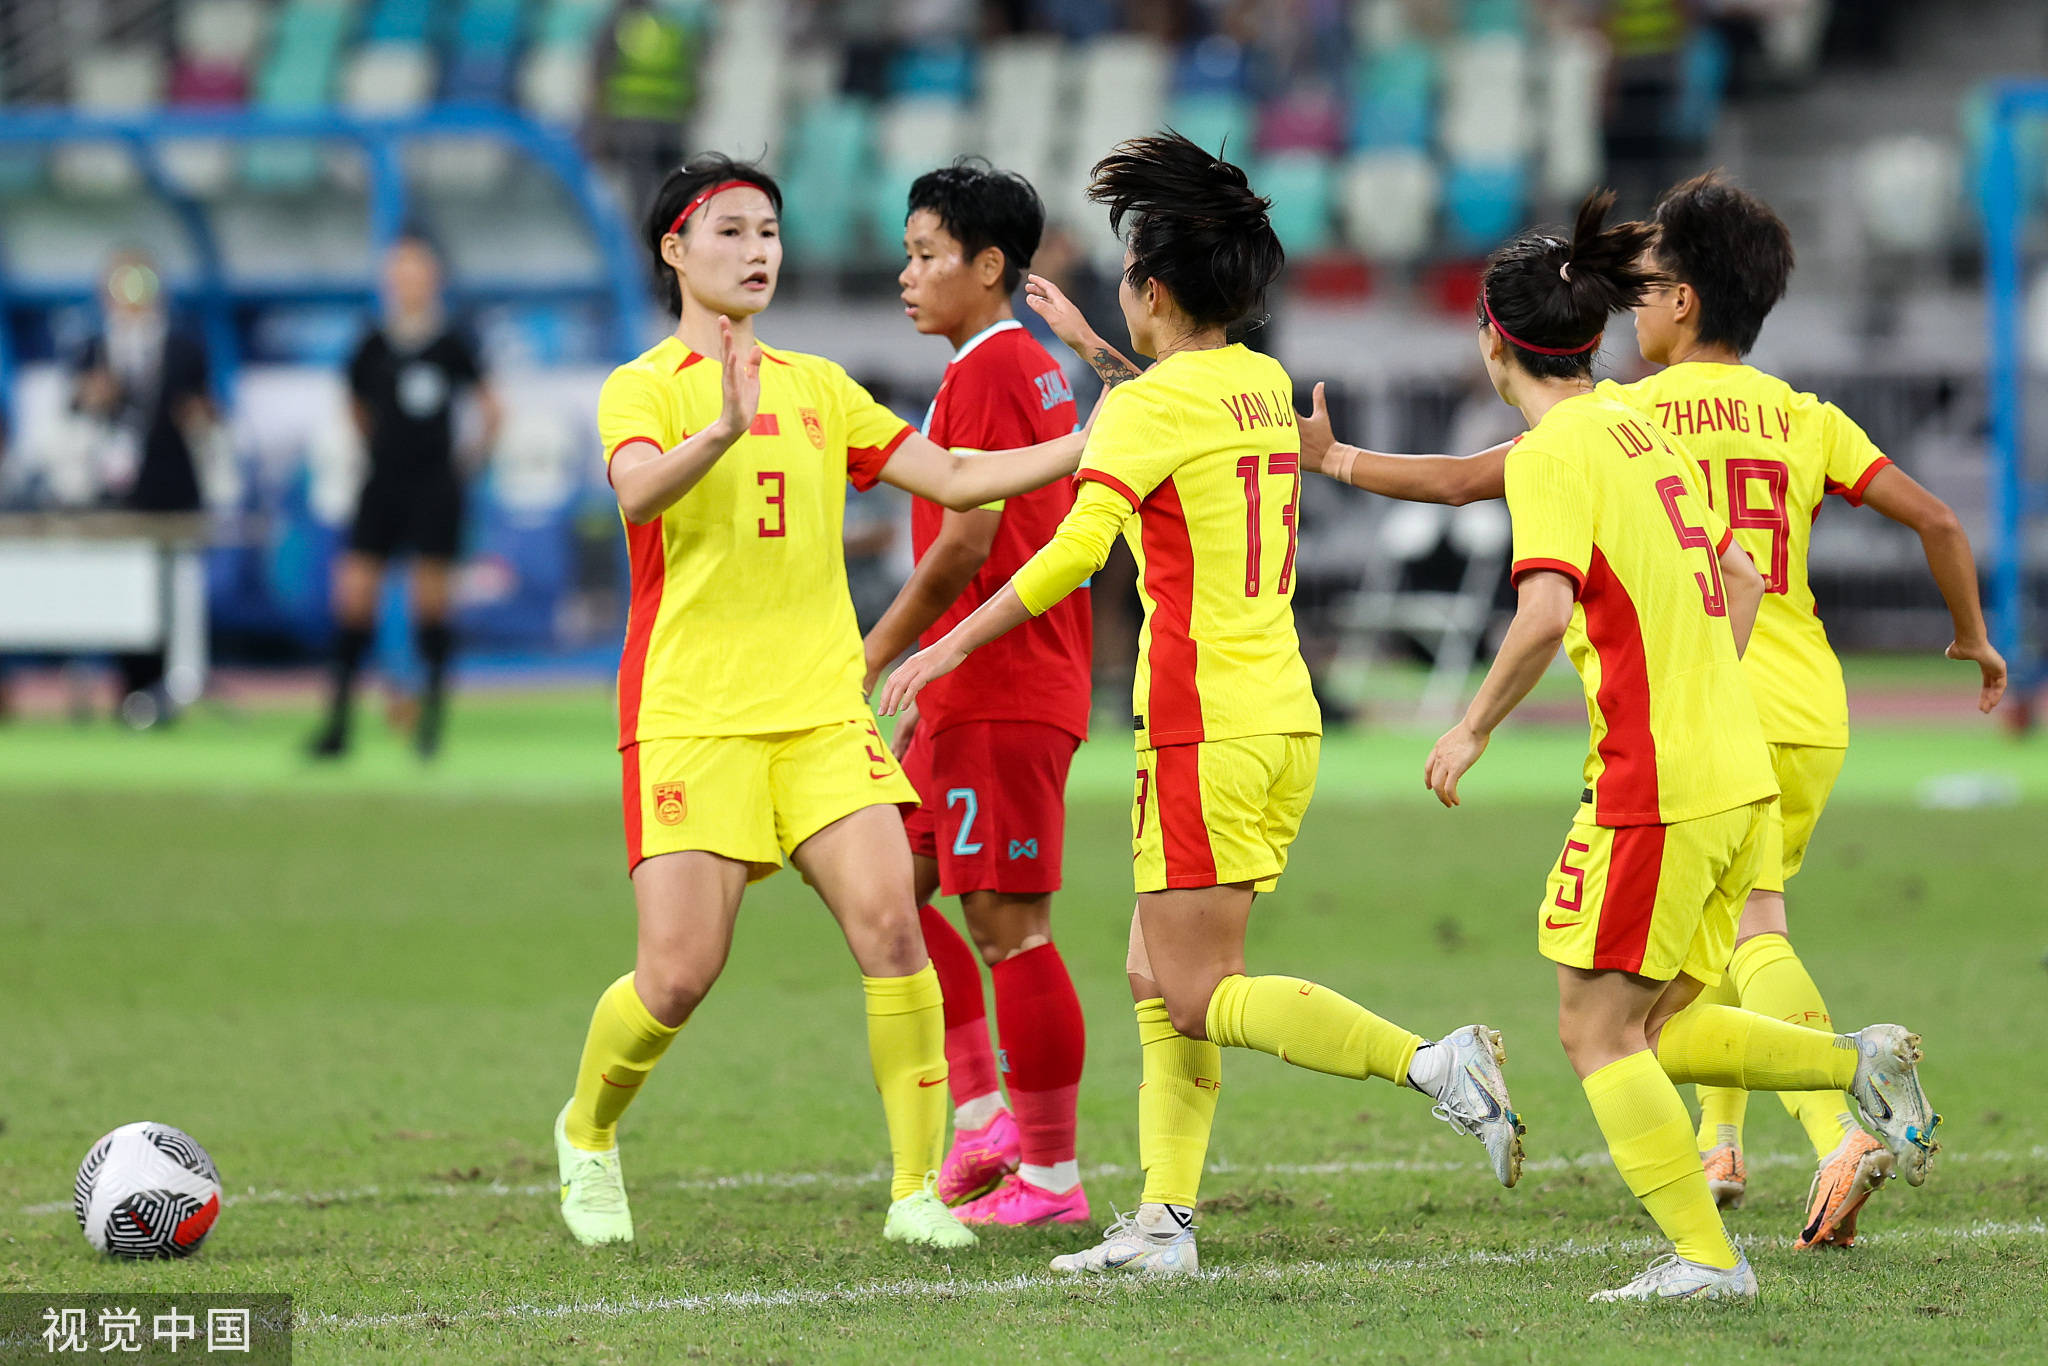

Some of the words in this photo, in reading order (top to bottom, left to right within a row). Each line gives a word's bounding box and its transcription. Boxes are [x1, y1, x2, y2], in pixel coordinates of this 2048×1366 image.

[1220, 393, 1273, 431] YAN
[1606, 418, 1654, 459] LIU
[1656, 397, 1750, 436] ZHANG
[757, 471, 786, 538] 3
[1655, 475, 1727, 617] 5
[946, 787, 984, 856] 2
[1554, 838, 1590, 913] 5
